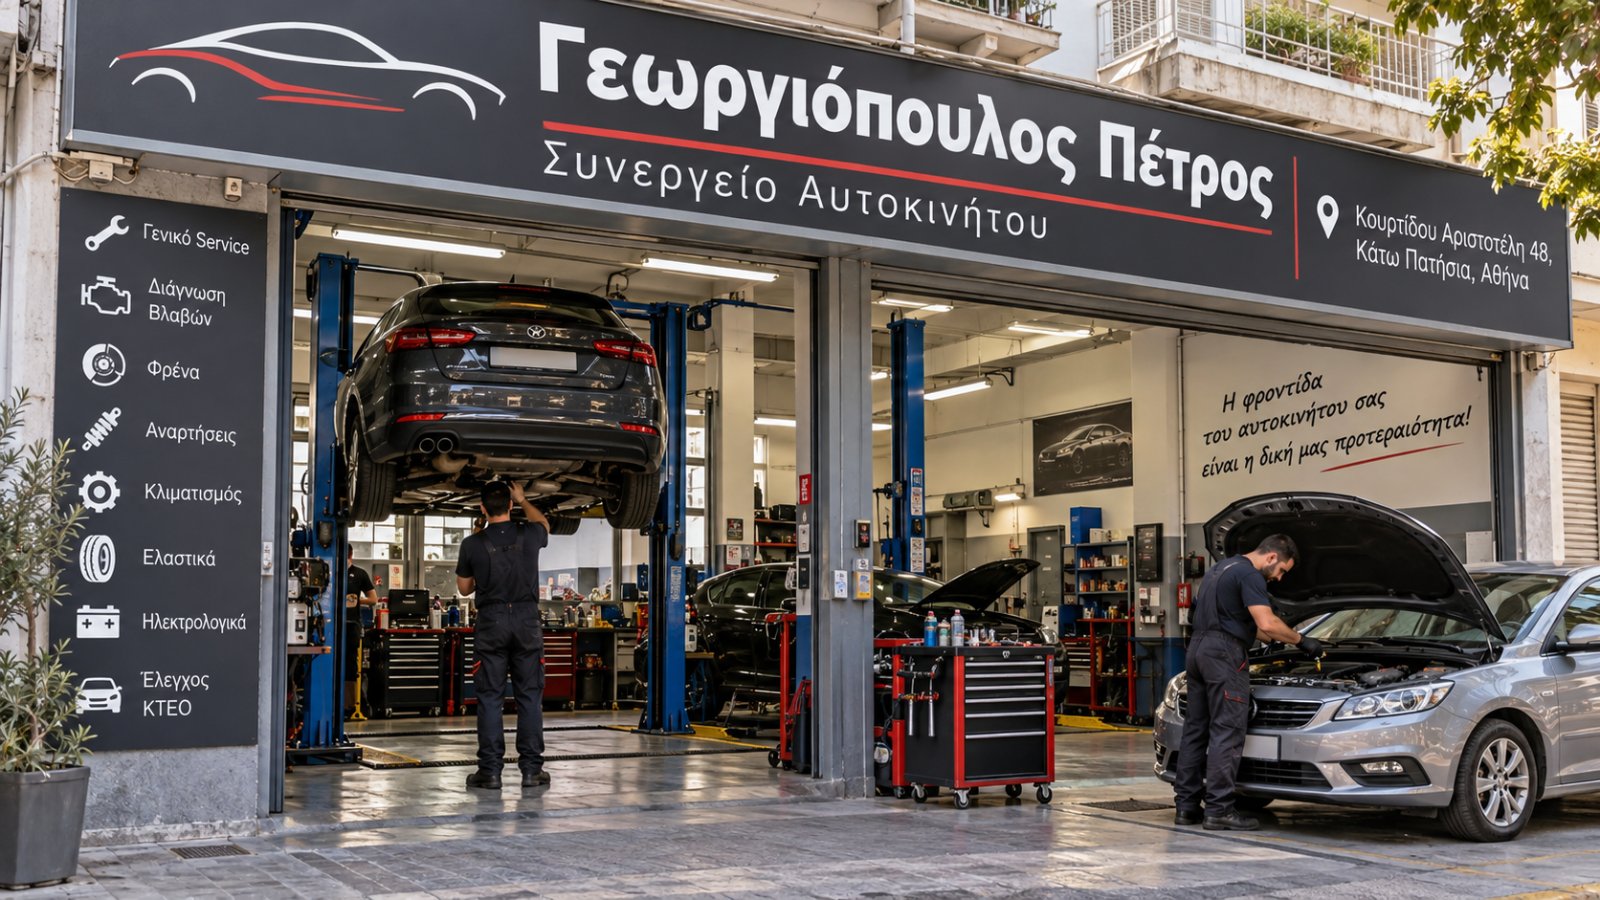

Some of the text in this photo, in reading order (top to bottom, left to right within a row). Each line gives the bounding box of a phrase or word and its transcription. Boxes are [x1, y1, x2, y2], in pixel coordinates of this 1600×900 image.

[539, 21, 1274, 220] Γεωργιόπουλος Πέτρος
[543, 139, 1047, 240] Συνεργείο Αυτοκινήτου
[143, 222, 250, 256] Γενικό Service
[1356, 204, 1553, 266] Κουρτίδου Αριστοτέλη 48,
[1356, 238, 1530, 293] Κάτω Πατήσια, Αθήνα
[148, 277, 226, 308] Διάγνωση
[149, 303, 213, 328] Βλαβών
[147, 359, 200, 381] Φρένα
[1222, 371, 1323, 413] Η φροντίδα
[1203, 389, 1387, 446] του αυτοκινήτου σας
[145, 421, 237, 447] Αναρτήσεις
[1202, 405, 1472, 478] είναι η δική μας προτεραιότητα!
[145, 482, 243, 506] Κλιματισμός
[143, 548, 216, 567] Ελαστικά
[142, 612, 247, 634] Ηλεκτρολογικά
[140, 671, 210, 692] Έλεγχος
[143, 699, 192, 717] ΚΤΕΟ
